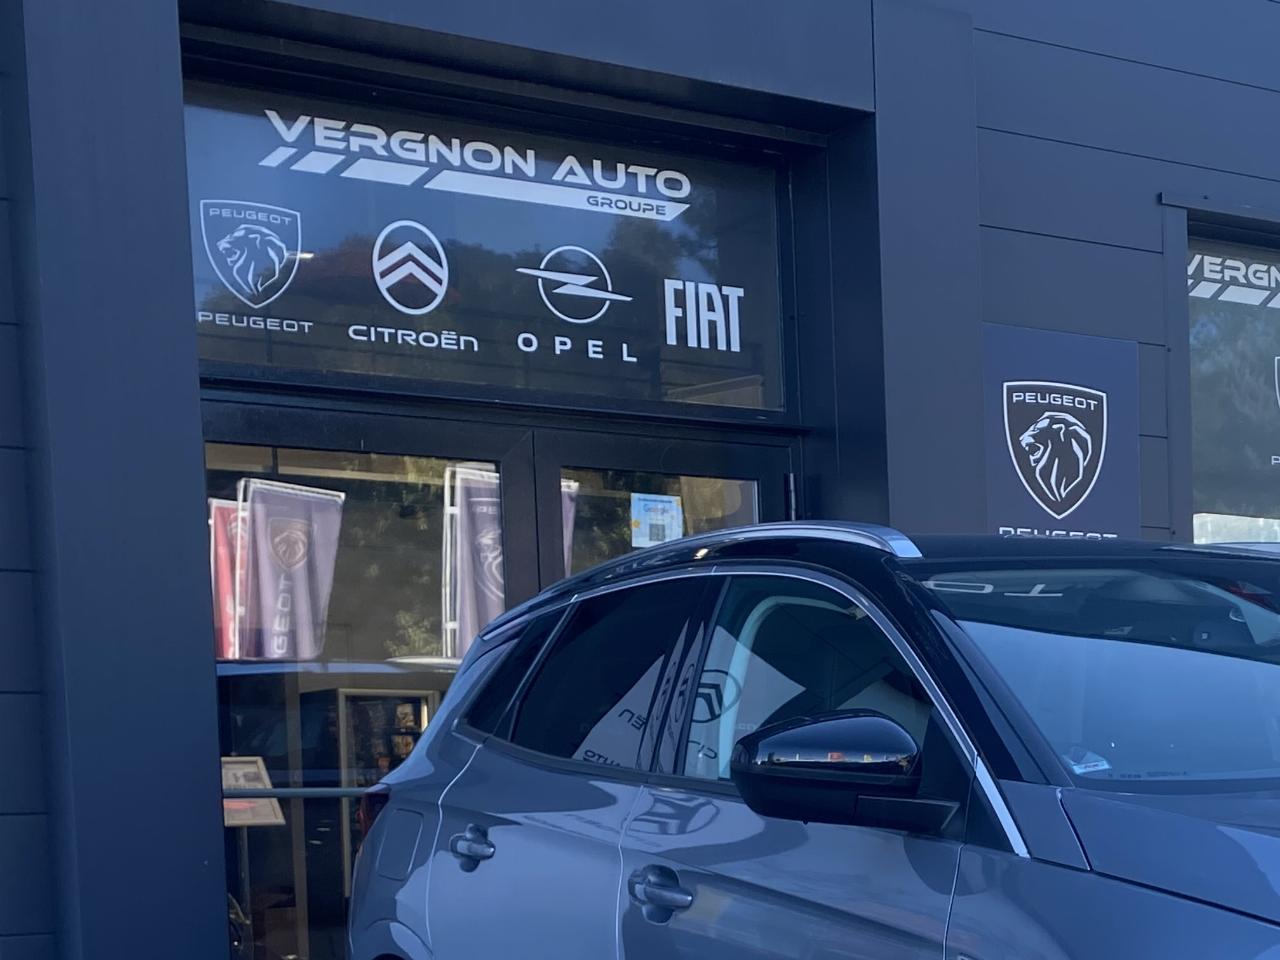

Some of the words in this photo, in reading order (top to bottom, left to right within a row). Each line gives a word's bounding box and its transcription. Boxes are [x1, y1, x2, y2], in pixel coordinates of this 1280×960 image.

[263, 109, 537, 178] VERGNON
[551, 155, 692, 199] AUTO
[209, 208, 292, 225] PEUGEOT
[586, 195, 667, 217] GROUPE
[198, 311, 314, 333] PEUGEOT
[664, 278, 744, 353] FIAT
[517, 332, 638, 363] OPEL
[1012, 391, 1098, 411] PEUGEOT
[272, 573, 292, 655] GEOT
